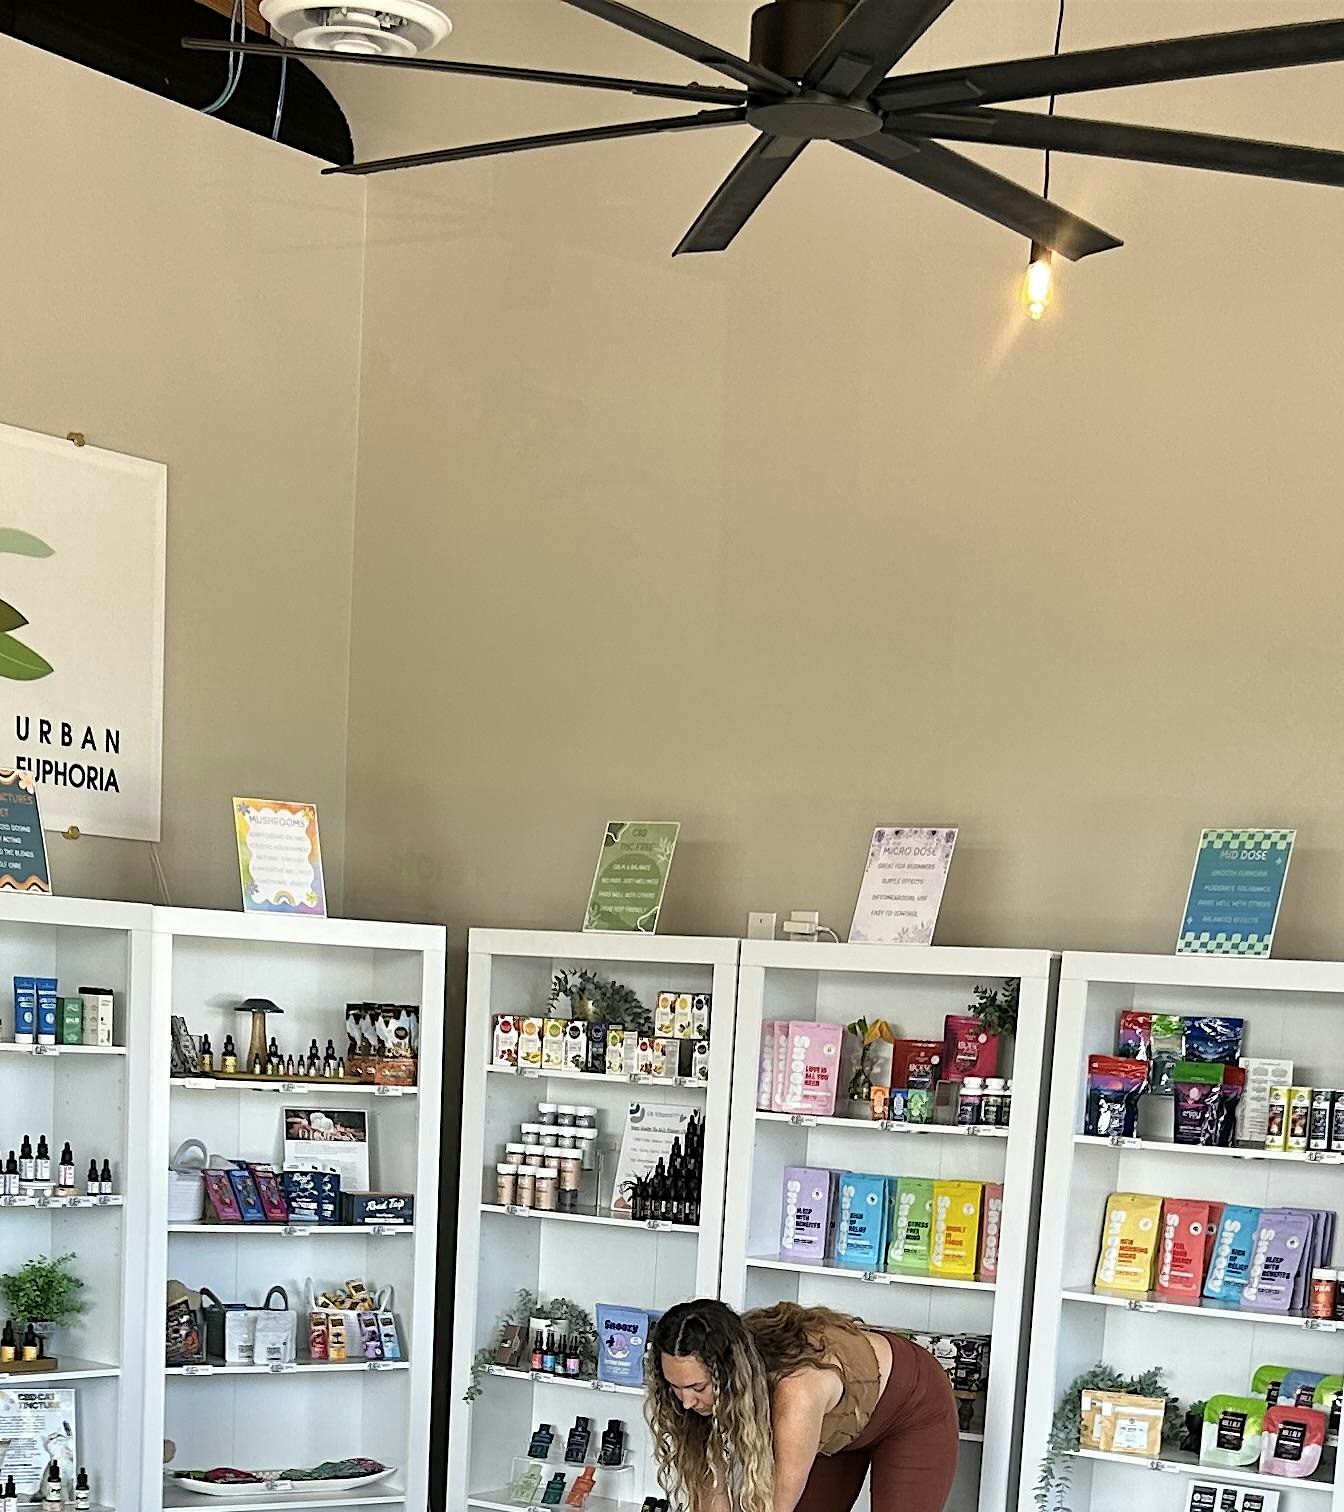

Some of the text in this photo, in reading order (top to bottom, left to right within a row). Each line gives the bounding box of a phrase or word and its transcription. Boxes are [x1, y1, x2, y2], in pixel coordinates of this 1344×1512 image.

[15, 715, 120, 755] URBAN
[15, 757, 120, 794] EUPHORIA
[249, 815, 306, 828] MUSHROOMS
[882, 846, 937, 857] MICRO DOSE
[1219, 849, 1268, 861] MID DOSE
[604, 1319, 639, 1334] Snoozy
